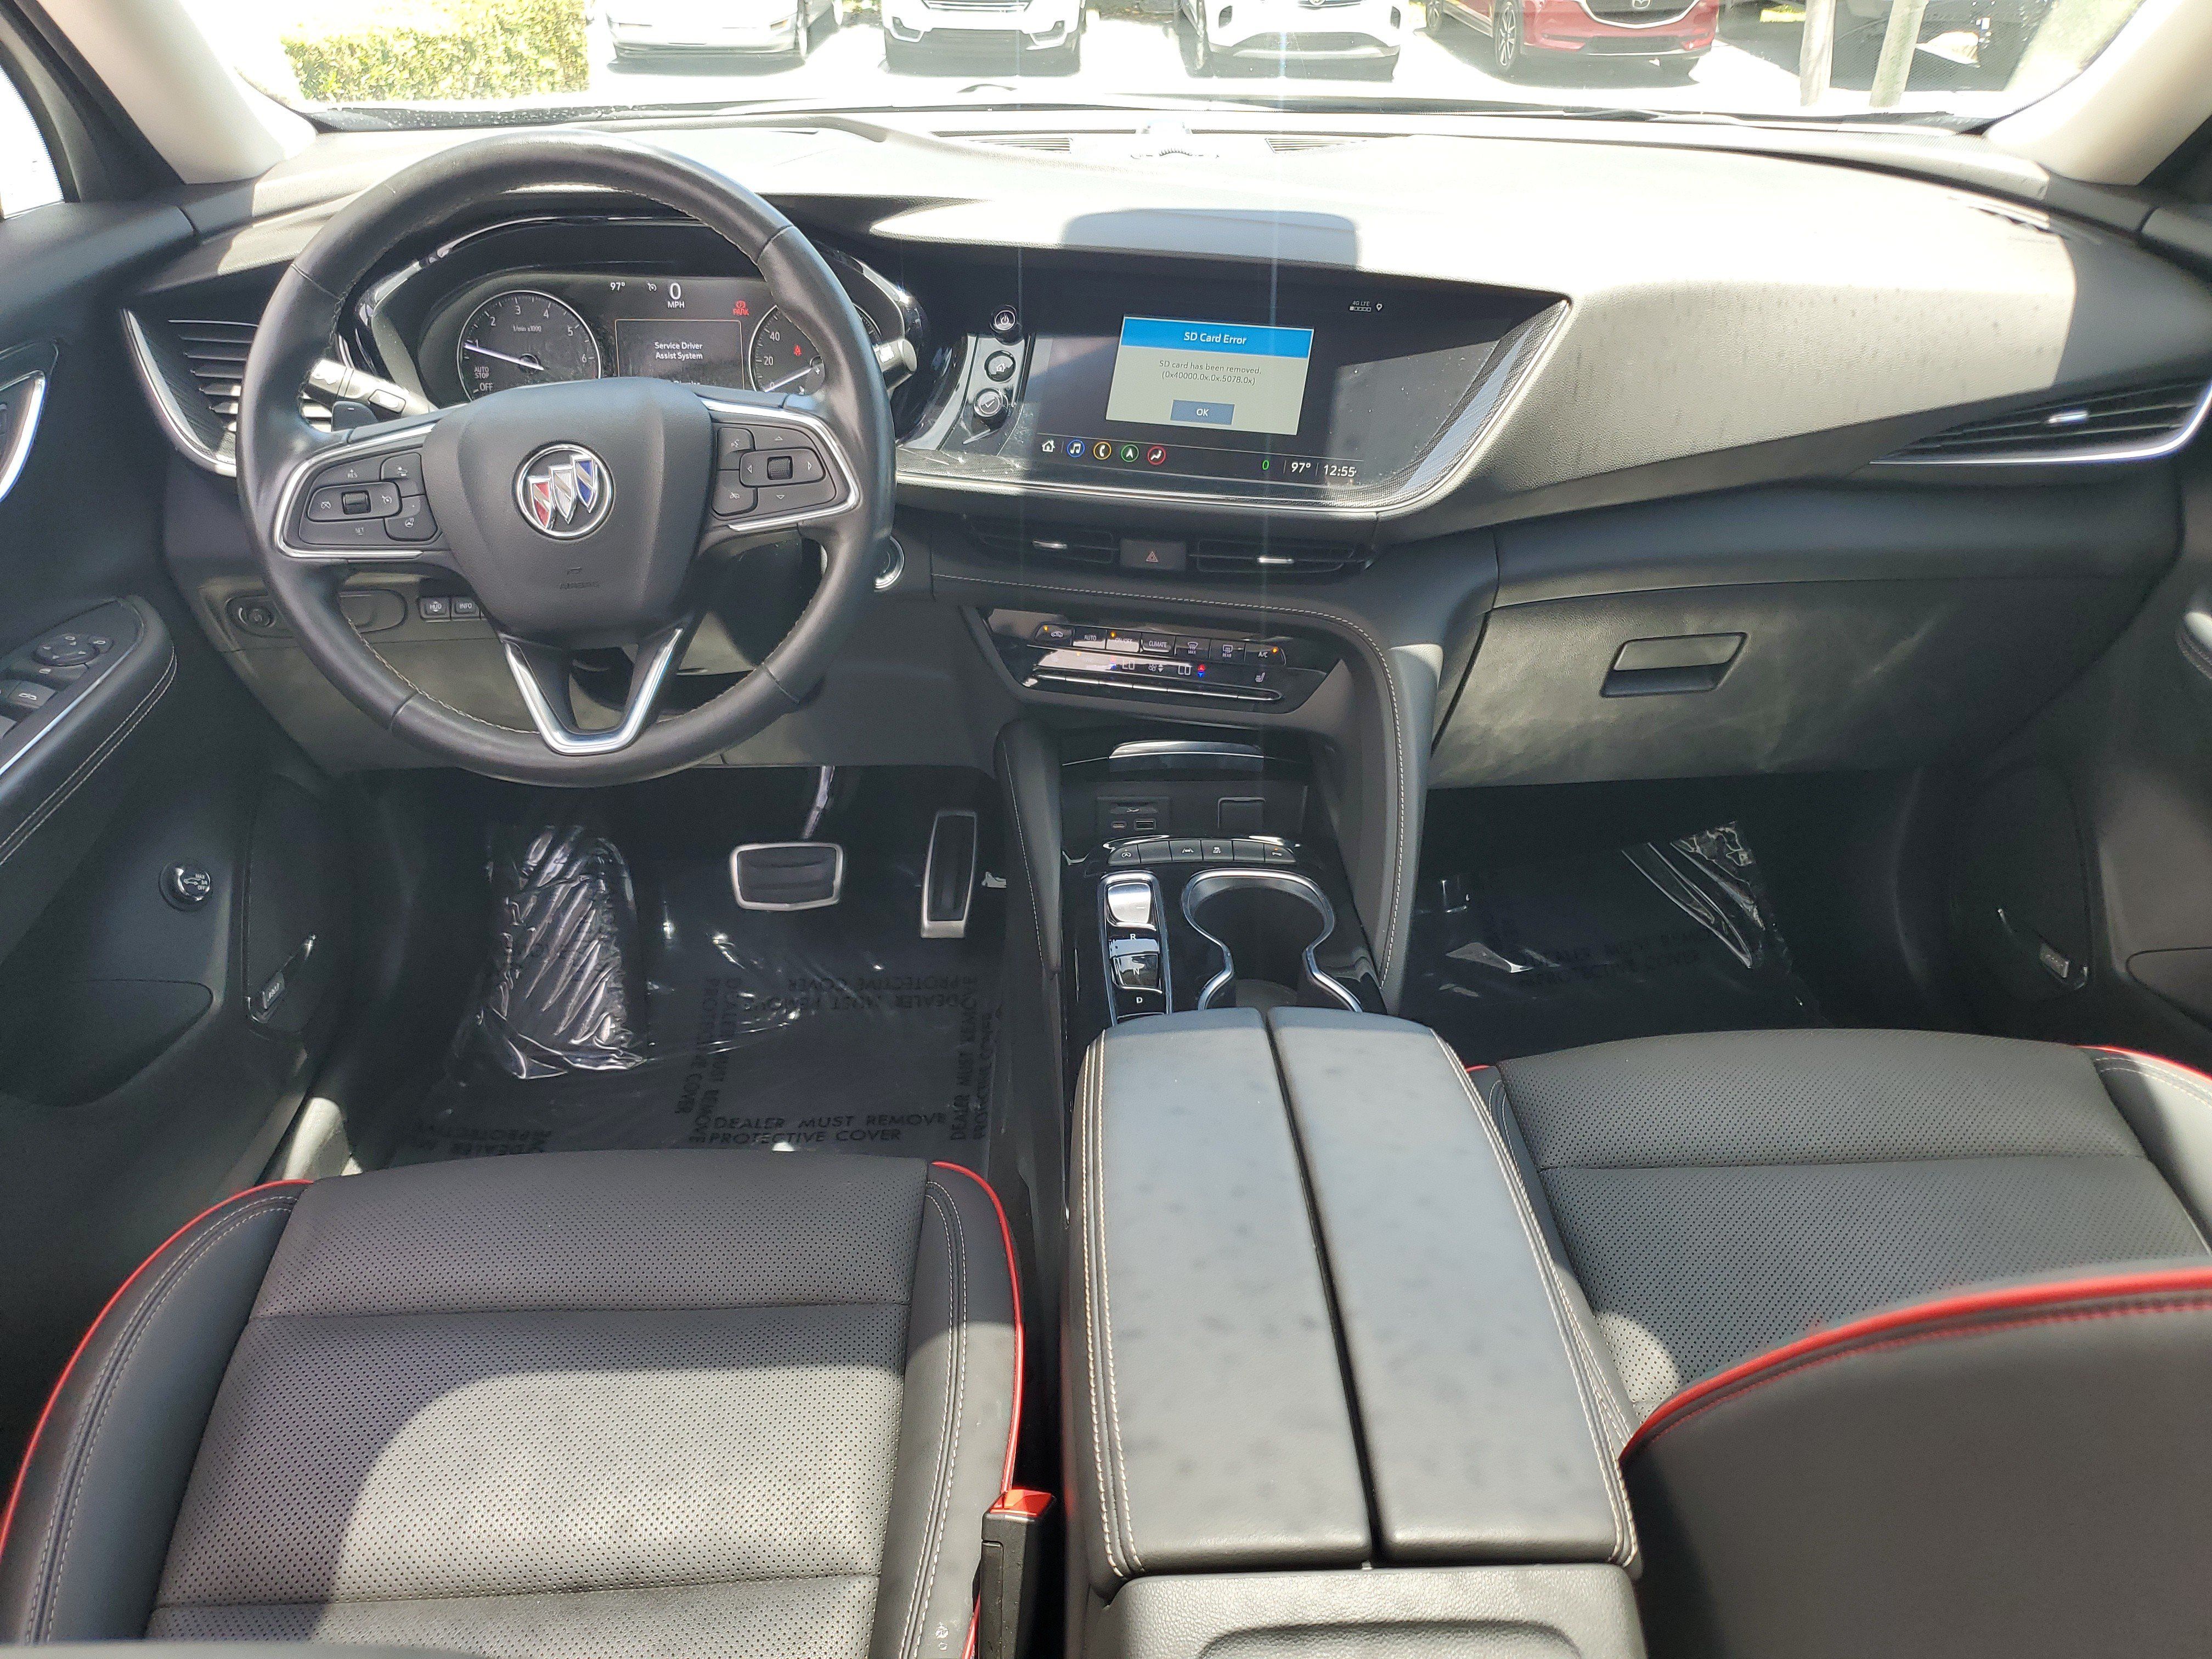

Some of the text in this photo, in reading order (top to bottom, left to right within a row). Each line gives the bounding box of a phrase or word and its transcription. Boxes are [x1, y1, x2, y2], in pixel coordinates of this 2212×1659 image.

[669, 283, 681, 300] 0
[515, 306, 521, 315] 3
[543, 309, 549, 319] 4
[490, 317, 496, 327] 2
[567, 326, 574, 336] 5
[770, 331, 780, 341] 40
[1183, 331, 1247, 345] SD Card Error
[475, 339, 479, 348] 1
[582, 354, 588, 363] 6
[678, 352, 703, 361] System
[764, 356, 774, 366] 20
[1205, 363, 1224, 371] been
[479, 383, 493, 392] OFF
[1196, 408, 1209, 417] OK
[1291, 462, 1355, 477] 97° 12:55
[1133, 967, 1139, 975] N
[713, 1113, 946, 1129] DEALER MUST REMOVE
[708, 1128, 901, 1144] PROTECTIVE COVER
